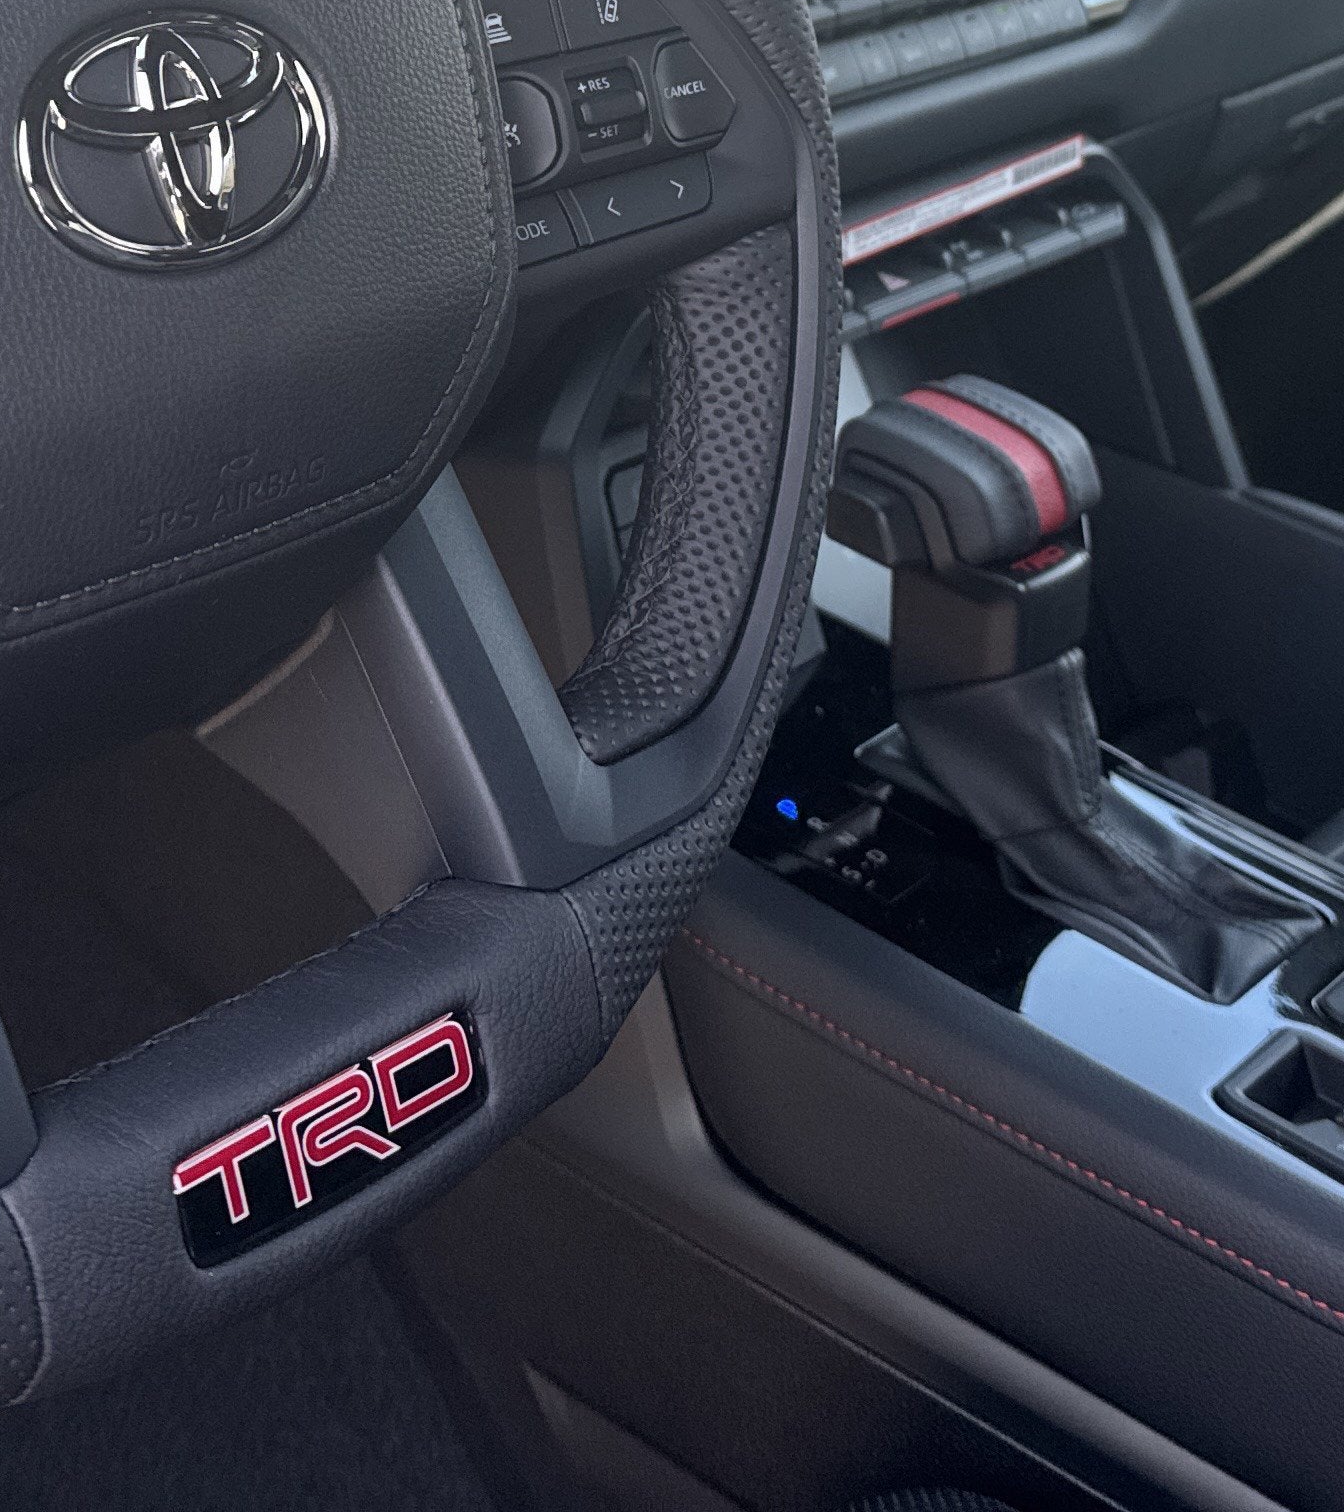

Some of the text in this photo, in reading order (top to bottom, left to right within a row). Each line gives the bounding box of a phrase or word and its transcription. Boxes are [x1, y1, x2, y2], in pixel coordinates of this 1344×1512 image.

[663, 80, 707, 99] CANCEL
[514, 220, 551, 242] ODE
[171, 1011, 474, 1225] TRD
